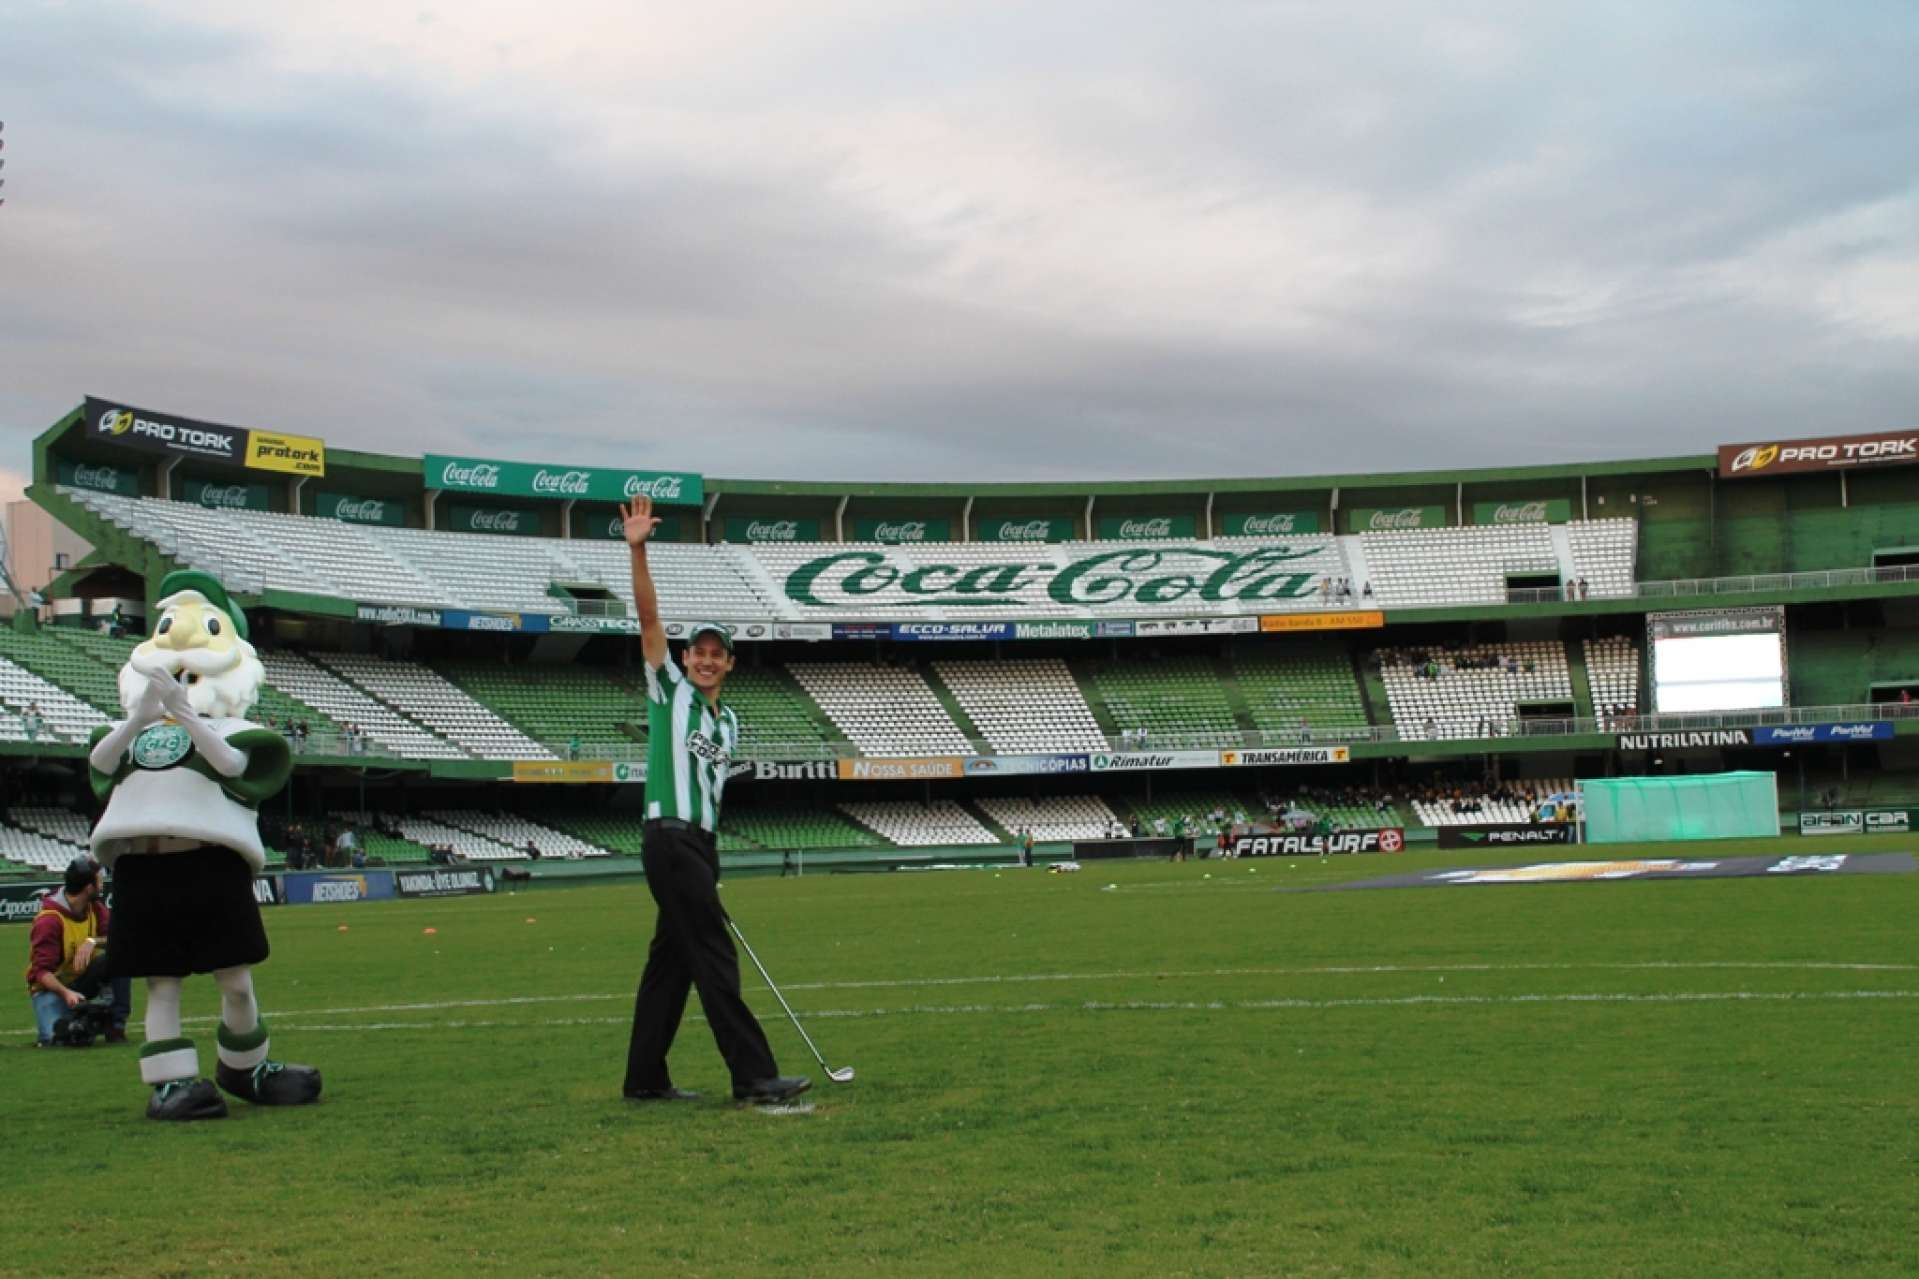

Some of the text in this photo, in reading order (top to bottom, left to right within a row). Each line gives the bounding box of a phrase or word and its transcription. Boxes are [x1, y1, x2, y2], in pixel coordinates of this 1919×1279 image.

[133, 418, 175, 440] PRO
[178, 428, 233, 450] TORK
[256, 445, 320, 462] protork
[1779, 444, 1838, 462] PRO
[1843, 437, 1919, 457] TORK
[898, 623, 1006, 635] ECCO-SALVA
[1015, 622, 1090, 639] Metalatex
[1620, 730, 1750, 750] NUTRILATINA
[1109, 755, 1175, 768] Rimatur
